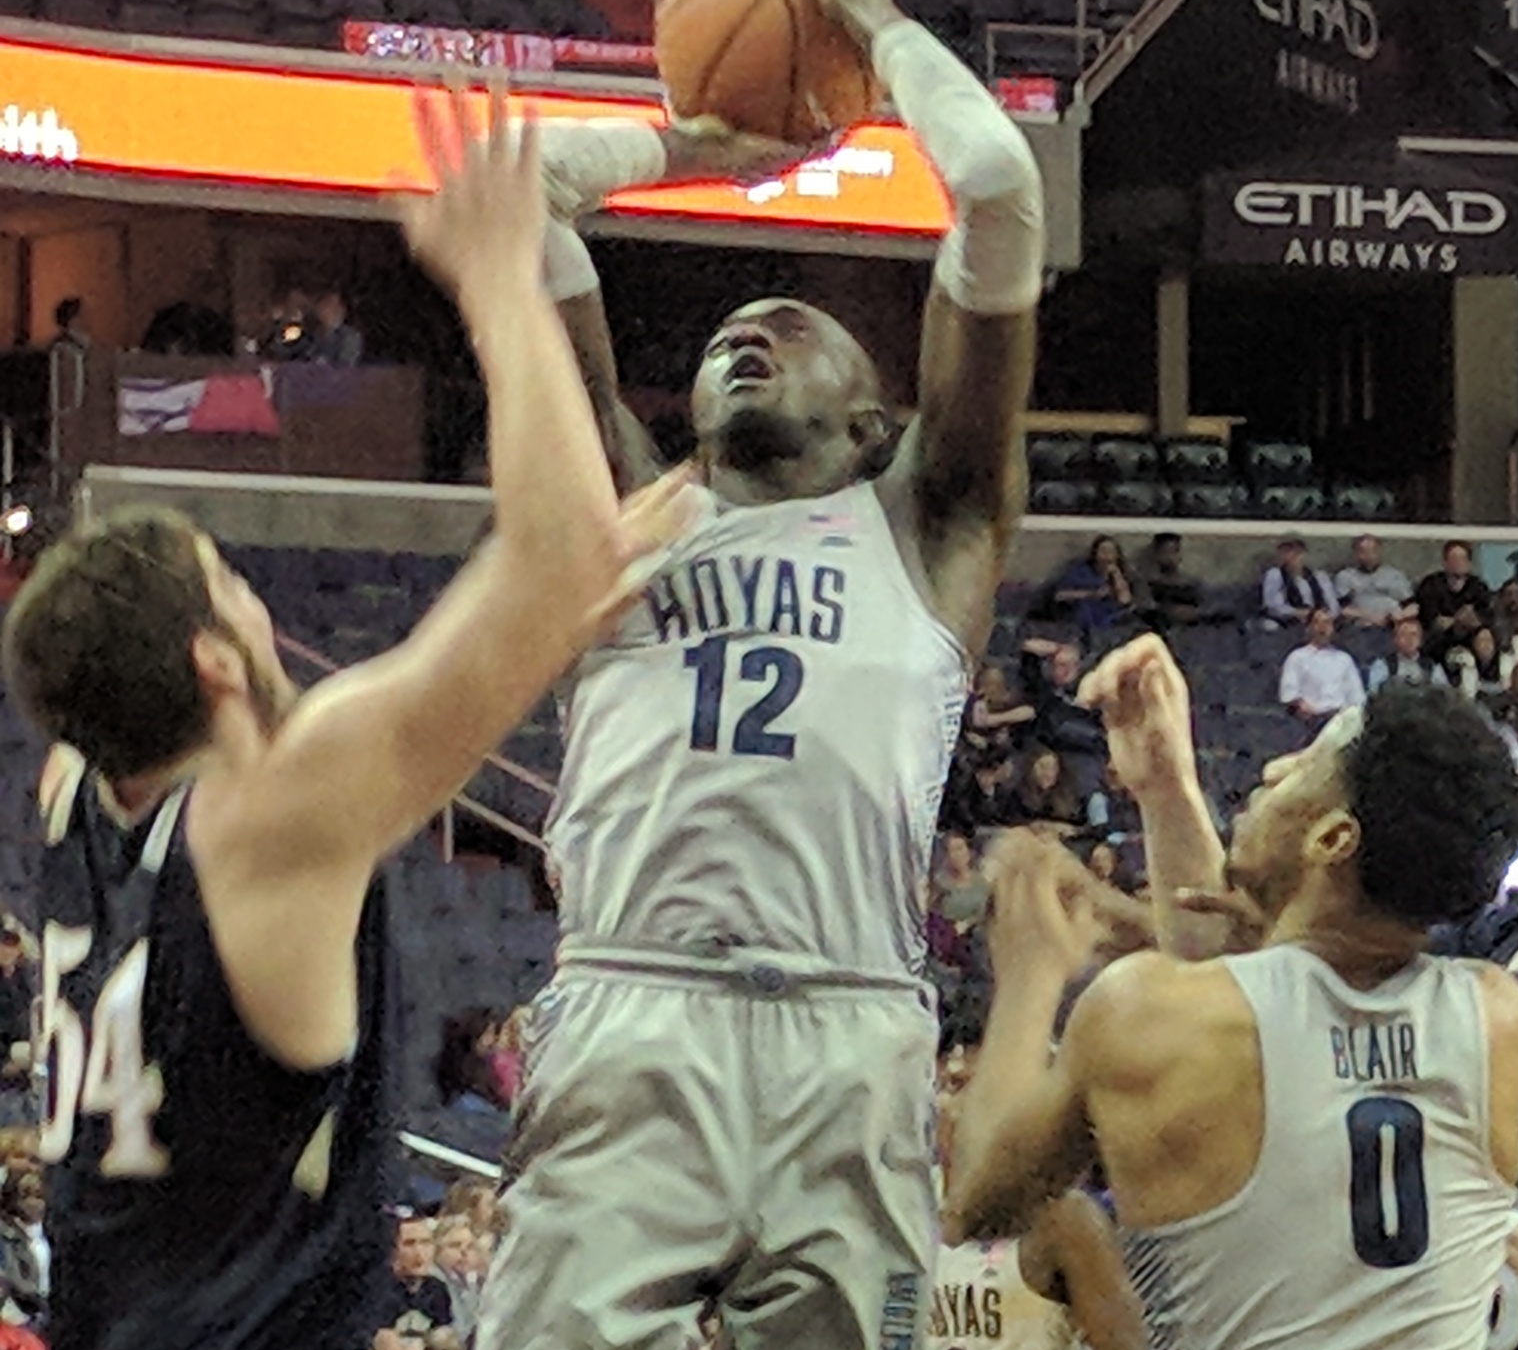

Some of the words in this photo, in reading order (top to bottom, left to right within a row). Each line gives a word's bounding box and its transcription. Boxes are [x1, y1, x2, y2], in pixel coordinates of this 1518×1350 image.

[0, 104, 79, 161] ith
[1234, 182, 1506, 234] ETIHAD
[1284, 238, 1460, 272] AIRWAYS
[642, 554, 847, 644] HOYAS
[683, 635, 805, 761] 12
[30, 918, 172, 1177] 54
[1329, 1022, 1418, 1082] BLAIR
[1346, 1096, 1429, 1268] 0
